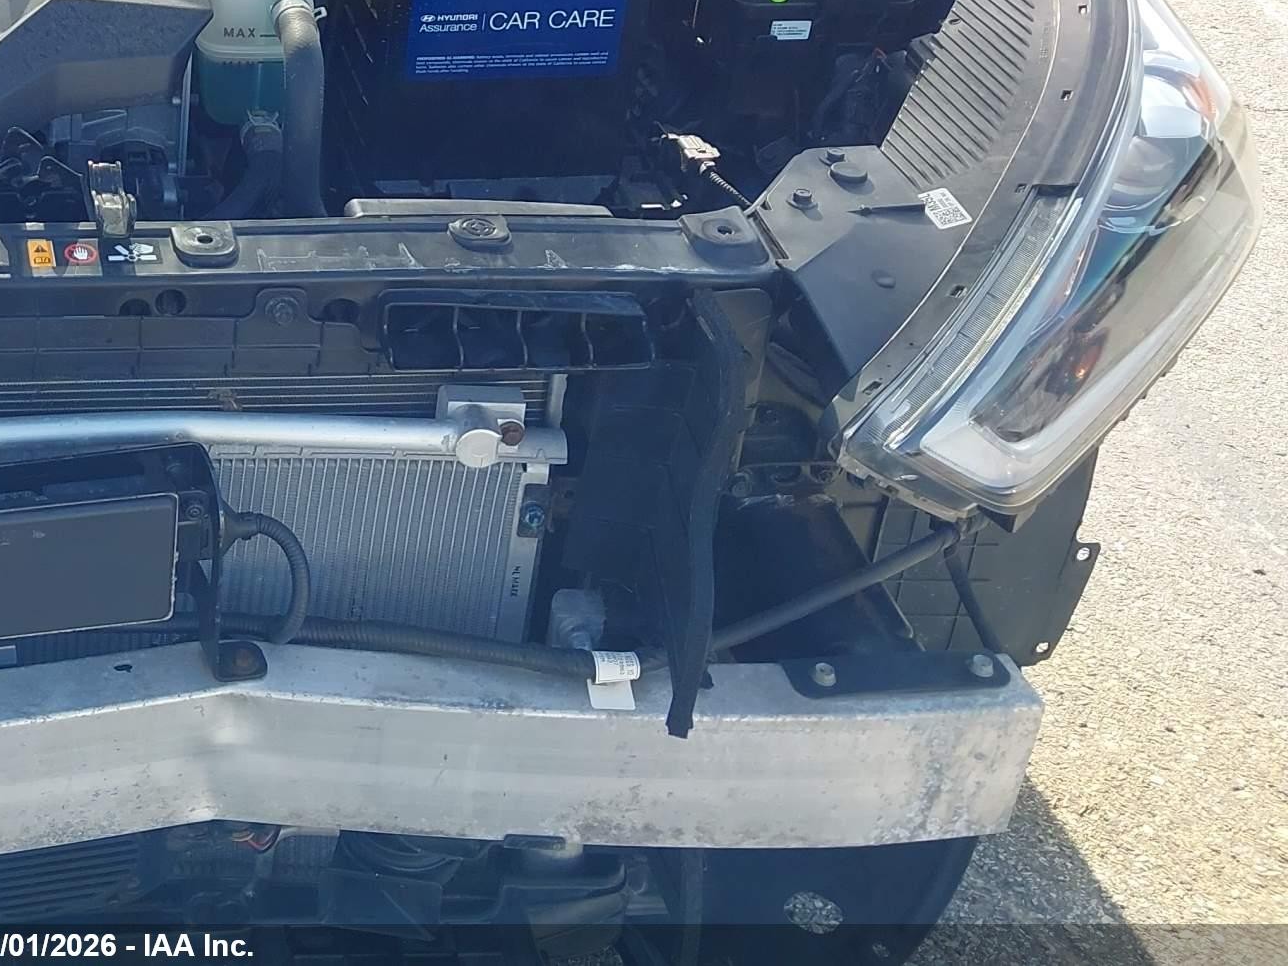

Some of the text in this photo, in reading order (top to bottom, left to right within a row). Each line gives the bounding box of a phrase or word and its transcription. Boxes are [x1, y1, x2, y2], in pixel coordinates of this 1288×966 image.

[489, 9, 616, 31] CAR CARE
[223, 27, 256, 38] MAX
[419, 23, 478, 33] Assurance
